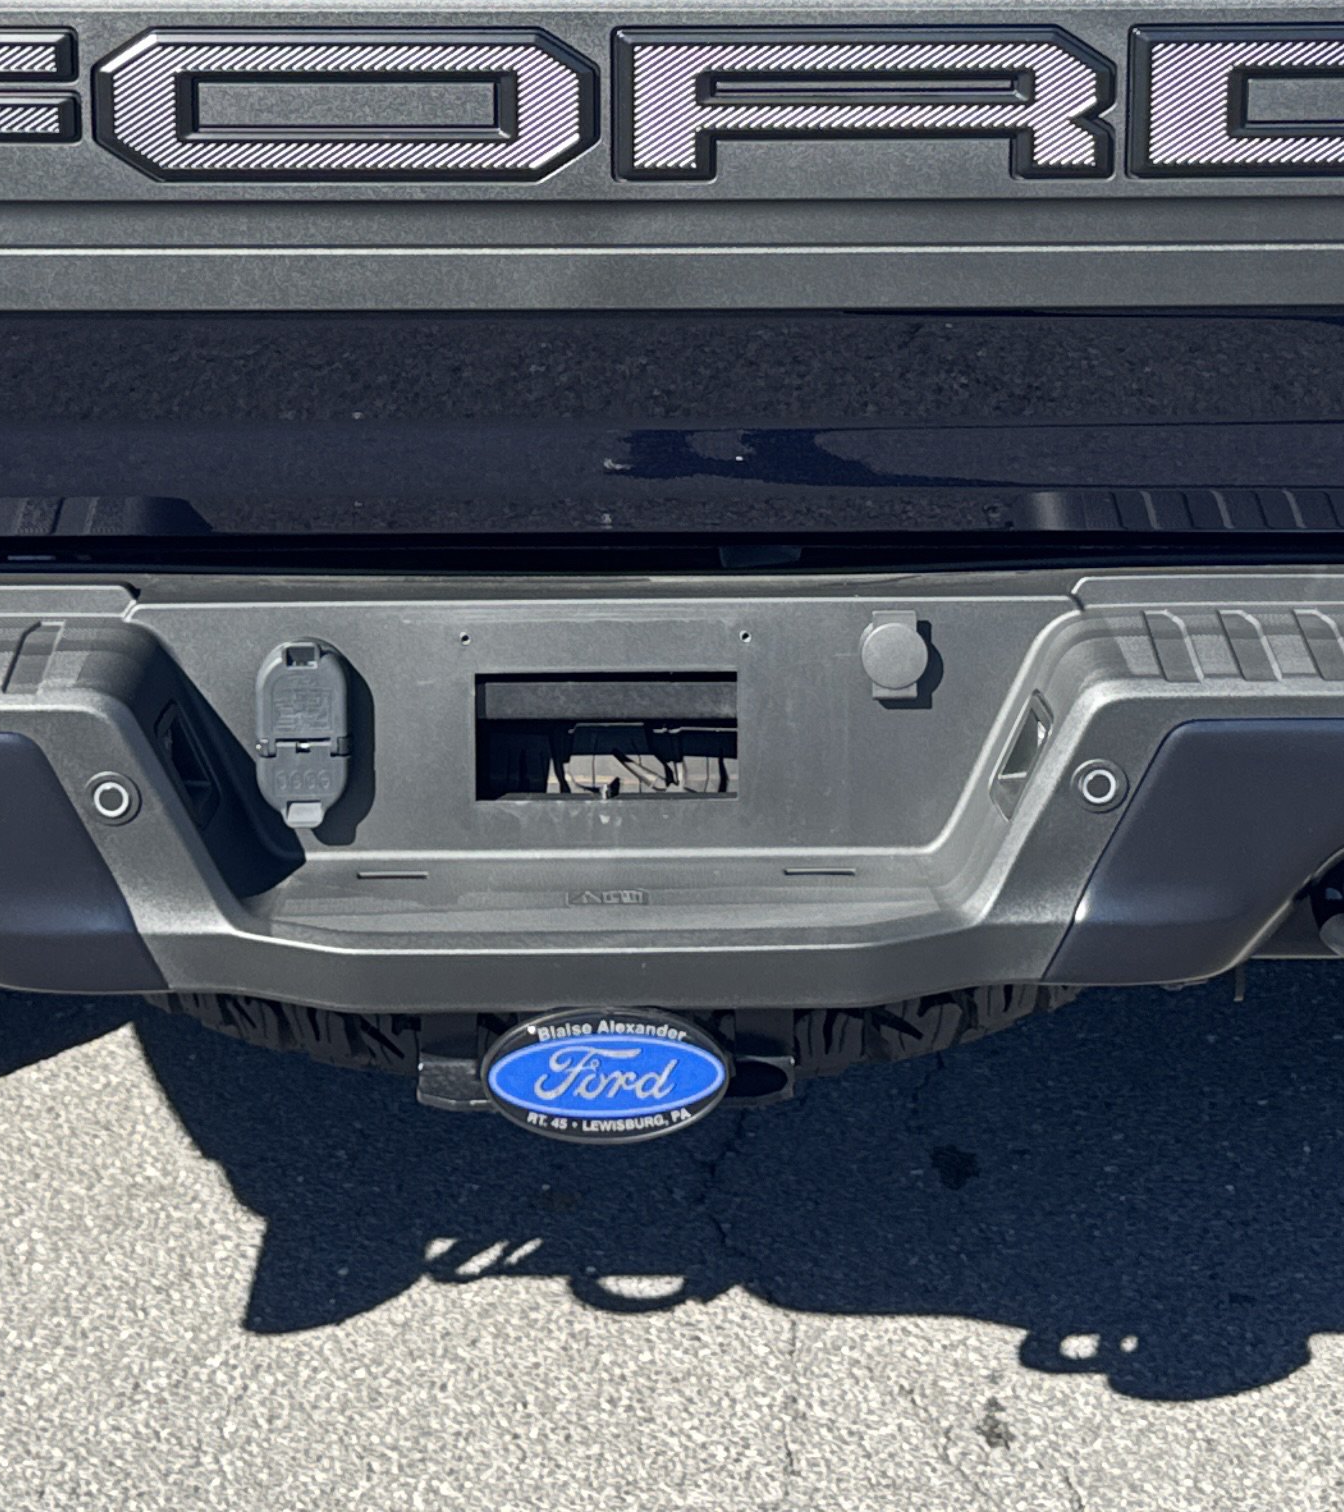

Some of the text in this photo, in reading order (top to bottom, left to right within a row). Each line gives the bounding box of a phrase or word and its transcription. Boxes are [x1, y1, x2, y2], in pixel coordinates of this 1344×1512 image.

[537, 1020, 687, 1042] Blaise Alexander
[534, 1045, 680, 1100] Ford
[527, 1107, 692, 1132] RT. 45 LEWISBURG, PA
